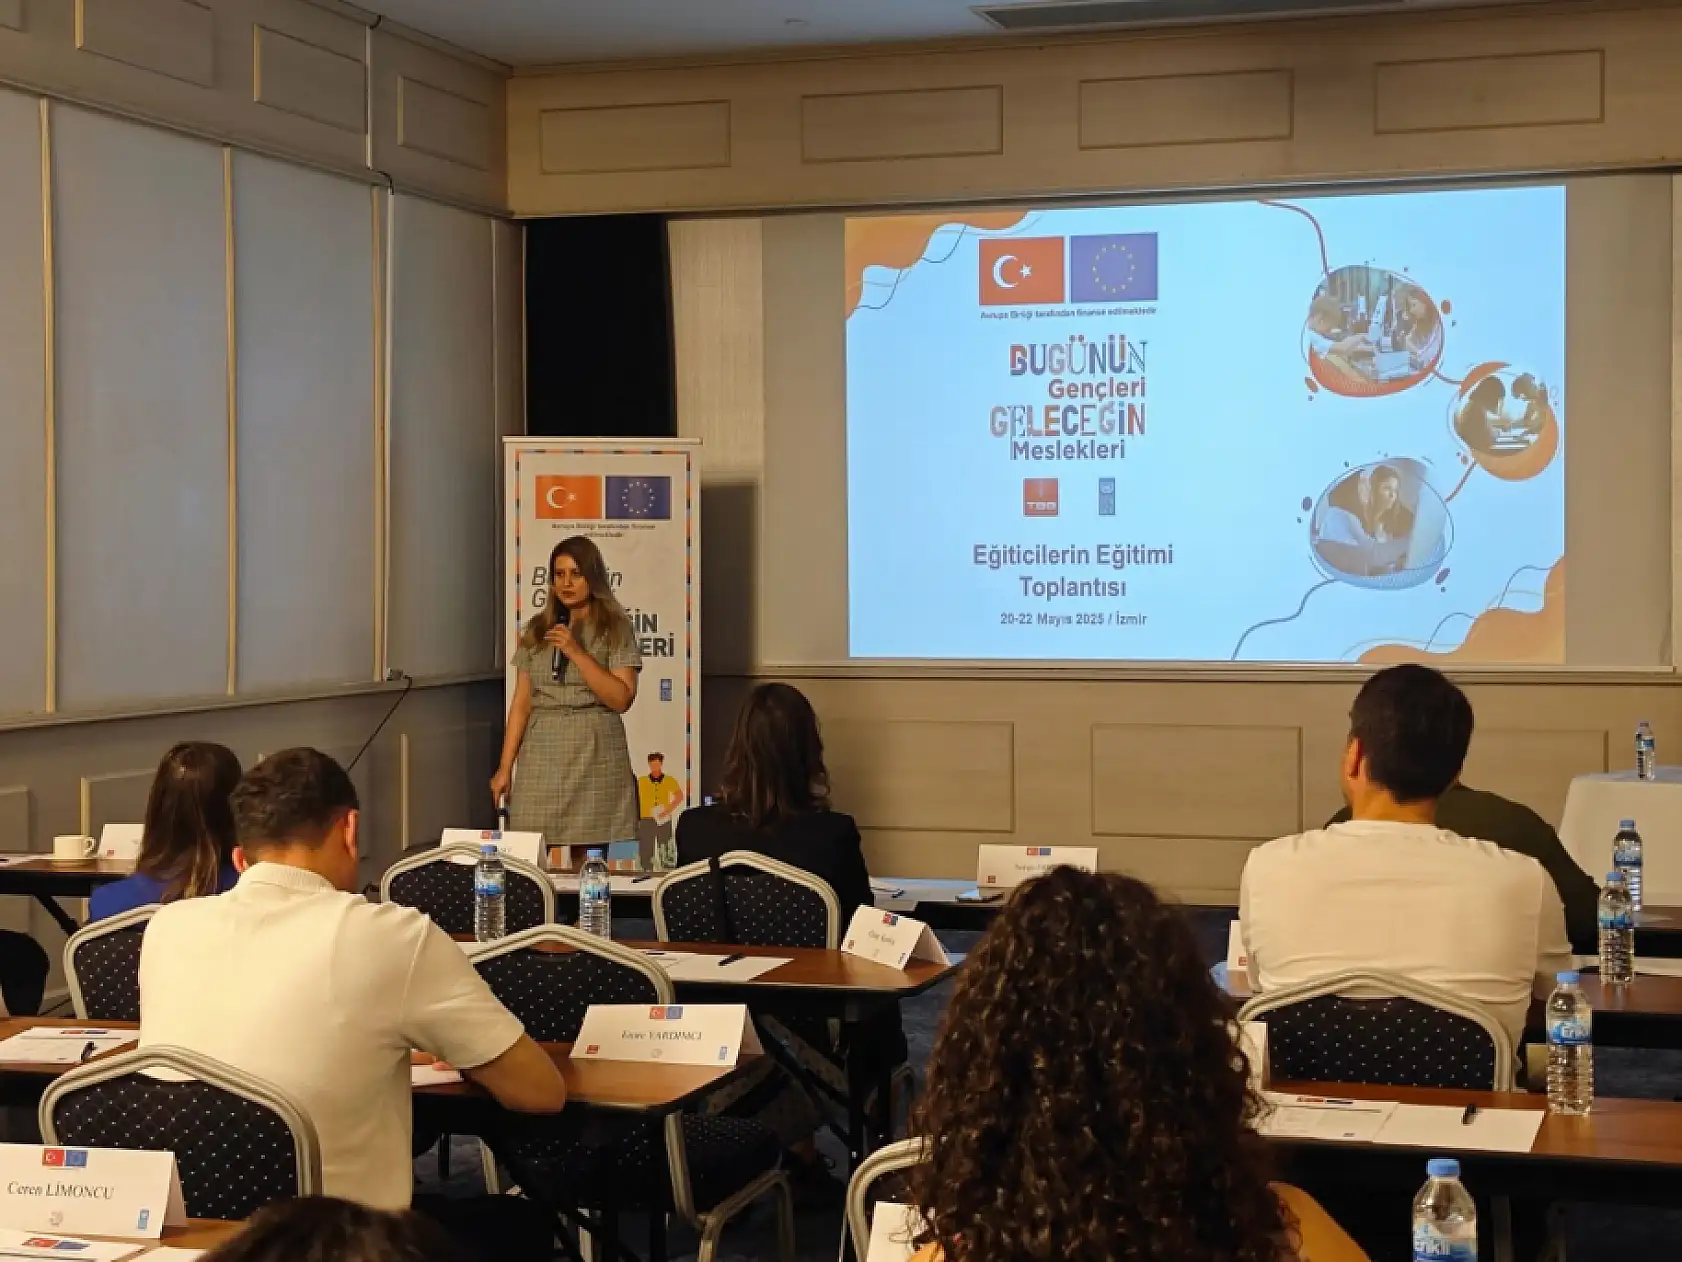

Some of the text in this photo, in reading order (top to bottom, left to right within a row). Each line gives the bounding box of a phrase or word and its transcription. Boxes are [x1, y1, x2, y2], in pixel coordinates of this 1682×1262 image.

[1010, 334, 1148, 376] BUGÜNÜN
[1048, 377, 1146, 401] Gençleri
[990, 401, 1146, 438] GELECEĞİN
[1011, 439, 1125, 460] Meslekleri
[973, 544, 1173, 570] Eğiticilerin Eğitimi
[1019, 576, 1126, 602] Toplantısı
[1000, 613, 1033, 625] 20-22
[1037, 613, 1072, 628] Mayıs
[1076, 612, 1104, 625] 2025
[1116, 610, 1148, 625] İzmir
[8, 1181, 114, 1200] Ceren LİMONCU
